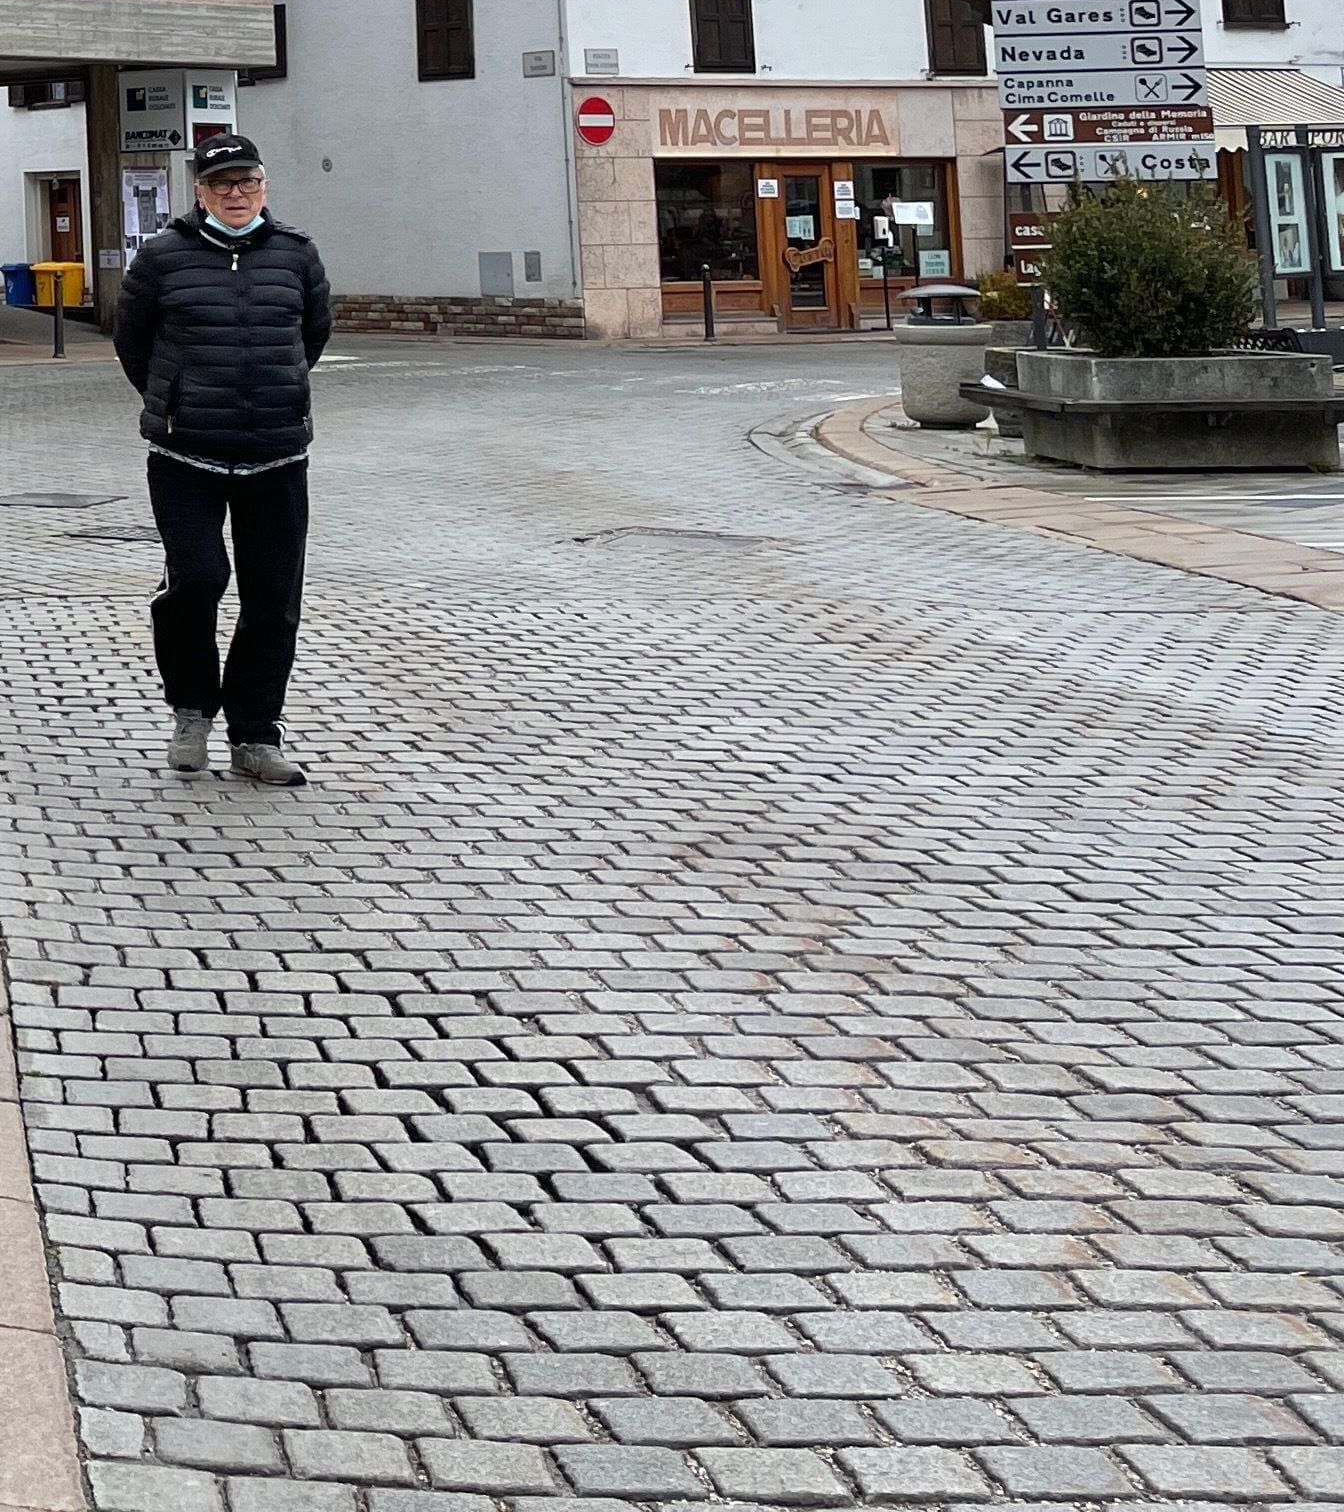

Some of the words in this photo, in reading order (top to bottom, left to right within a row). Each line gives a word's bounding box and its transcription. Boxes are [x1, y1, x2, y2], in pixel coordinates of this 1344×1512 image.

[996, 9, 1036, 25] Val
[1046, 7, 1113, 24] Gares
[1001, 45, 1085, 62] Nevada
[1004, 77, 1074, 90] Capanna
[1005, 93, 1045, 104] Cima
[1047, 91, 1115, 103] Comelle
[1079, 111, 1125, 121] Giardino
[1129, 110, 1156, 119] della
[1161, 110, 1207, 119] Memoria
[659, 109, 890, 146] MACELLERIA
[1095, 127, 1145, 136] Campagna
[1162, 125, 1193, 133] Russia
[1260, 130, 1289, 146] BAR
[1141, 153, 1210, 170] Costa
